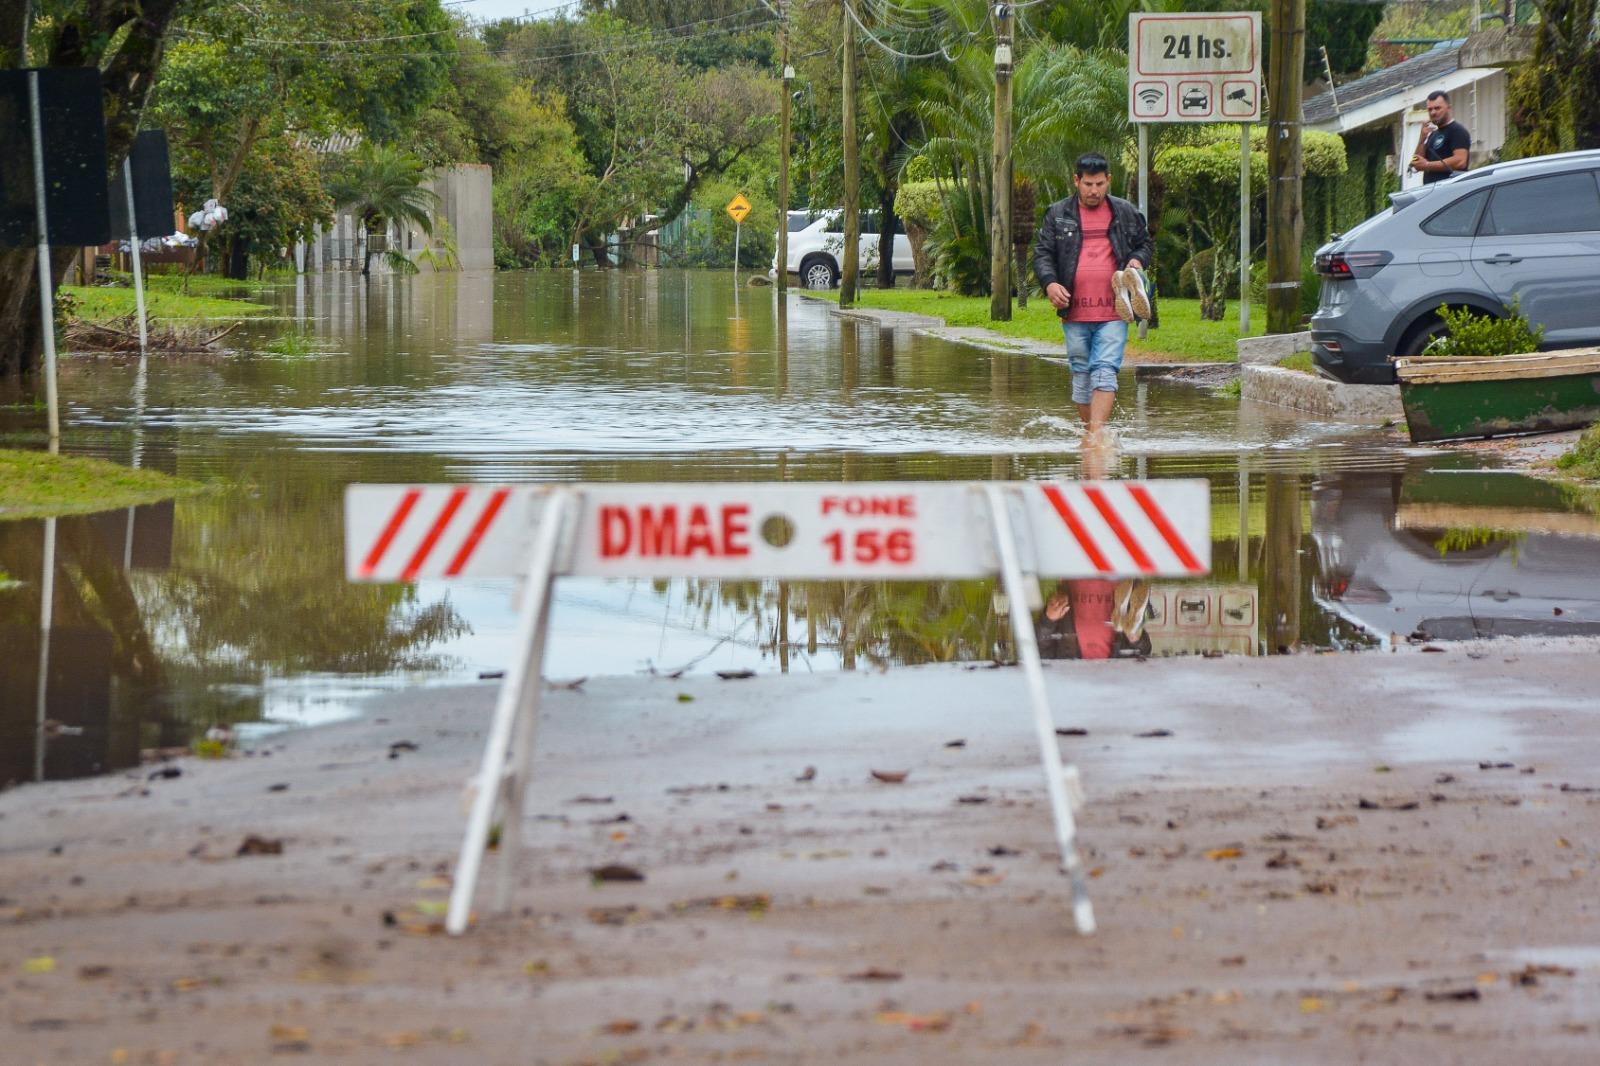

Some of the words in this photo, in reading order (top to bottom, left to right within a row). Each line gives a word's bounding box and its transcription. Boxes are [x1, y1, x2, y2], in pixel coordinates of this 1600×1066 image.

[1163, 35, 1192, 60] 24
[1197, 34, 1232, 60] hs.
[1073, 296, 1113, 308] NGLAN
[821, 496, 916, 517] FONE
[599, 504, 750, 558] DMAE
[822, 529, 914, 564] 156
